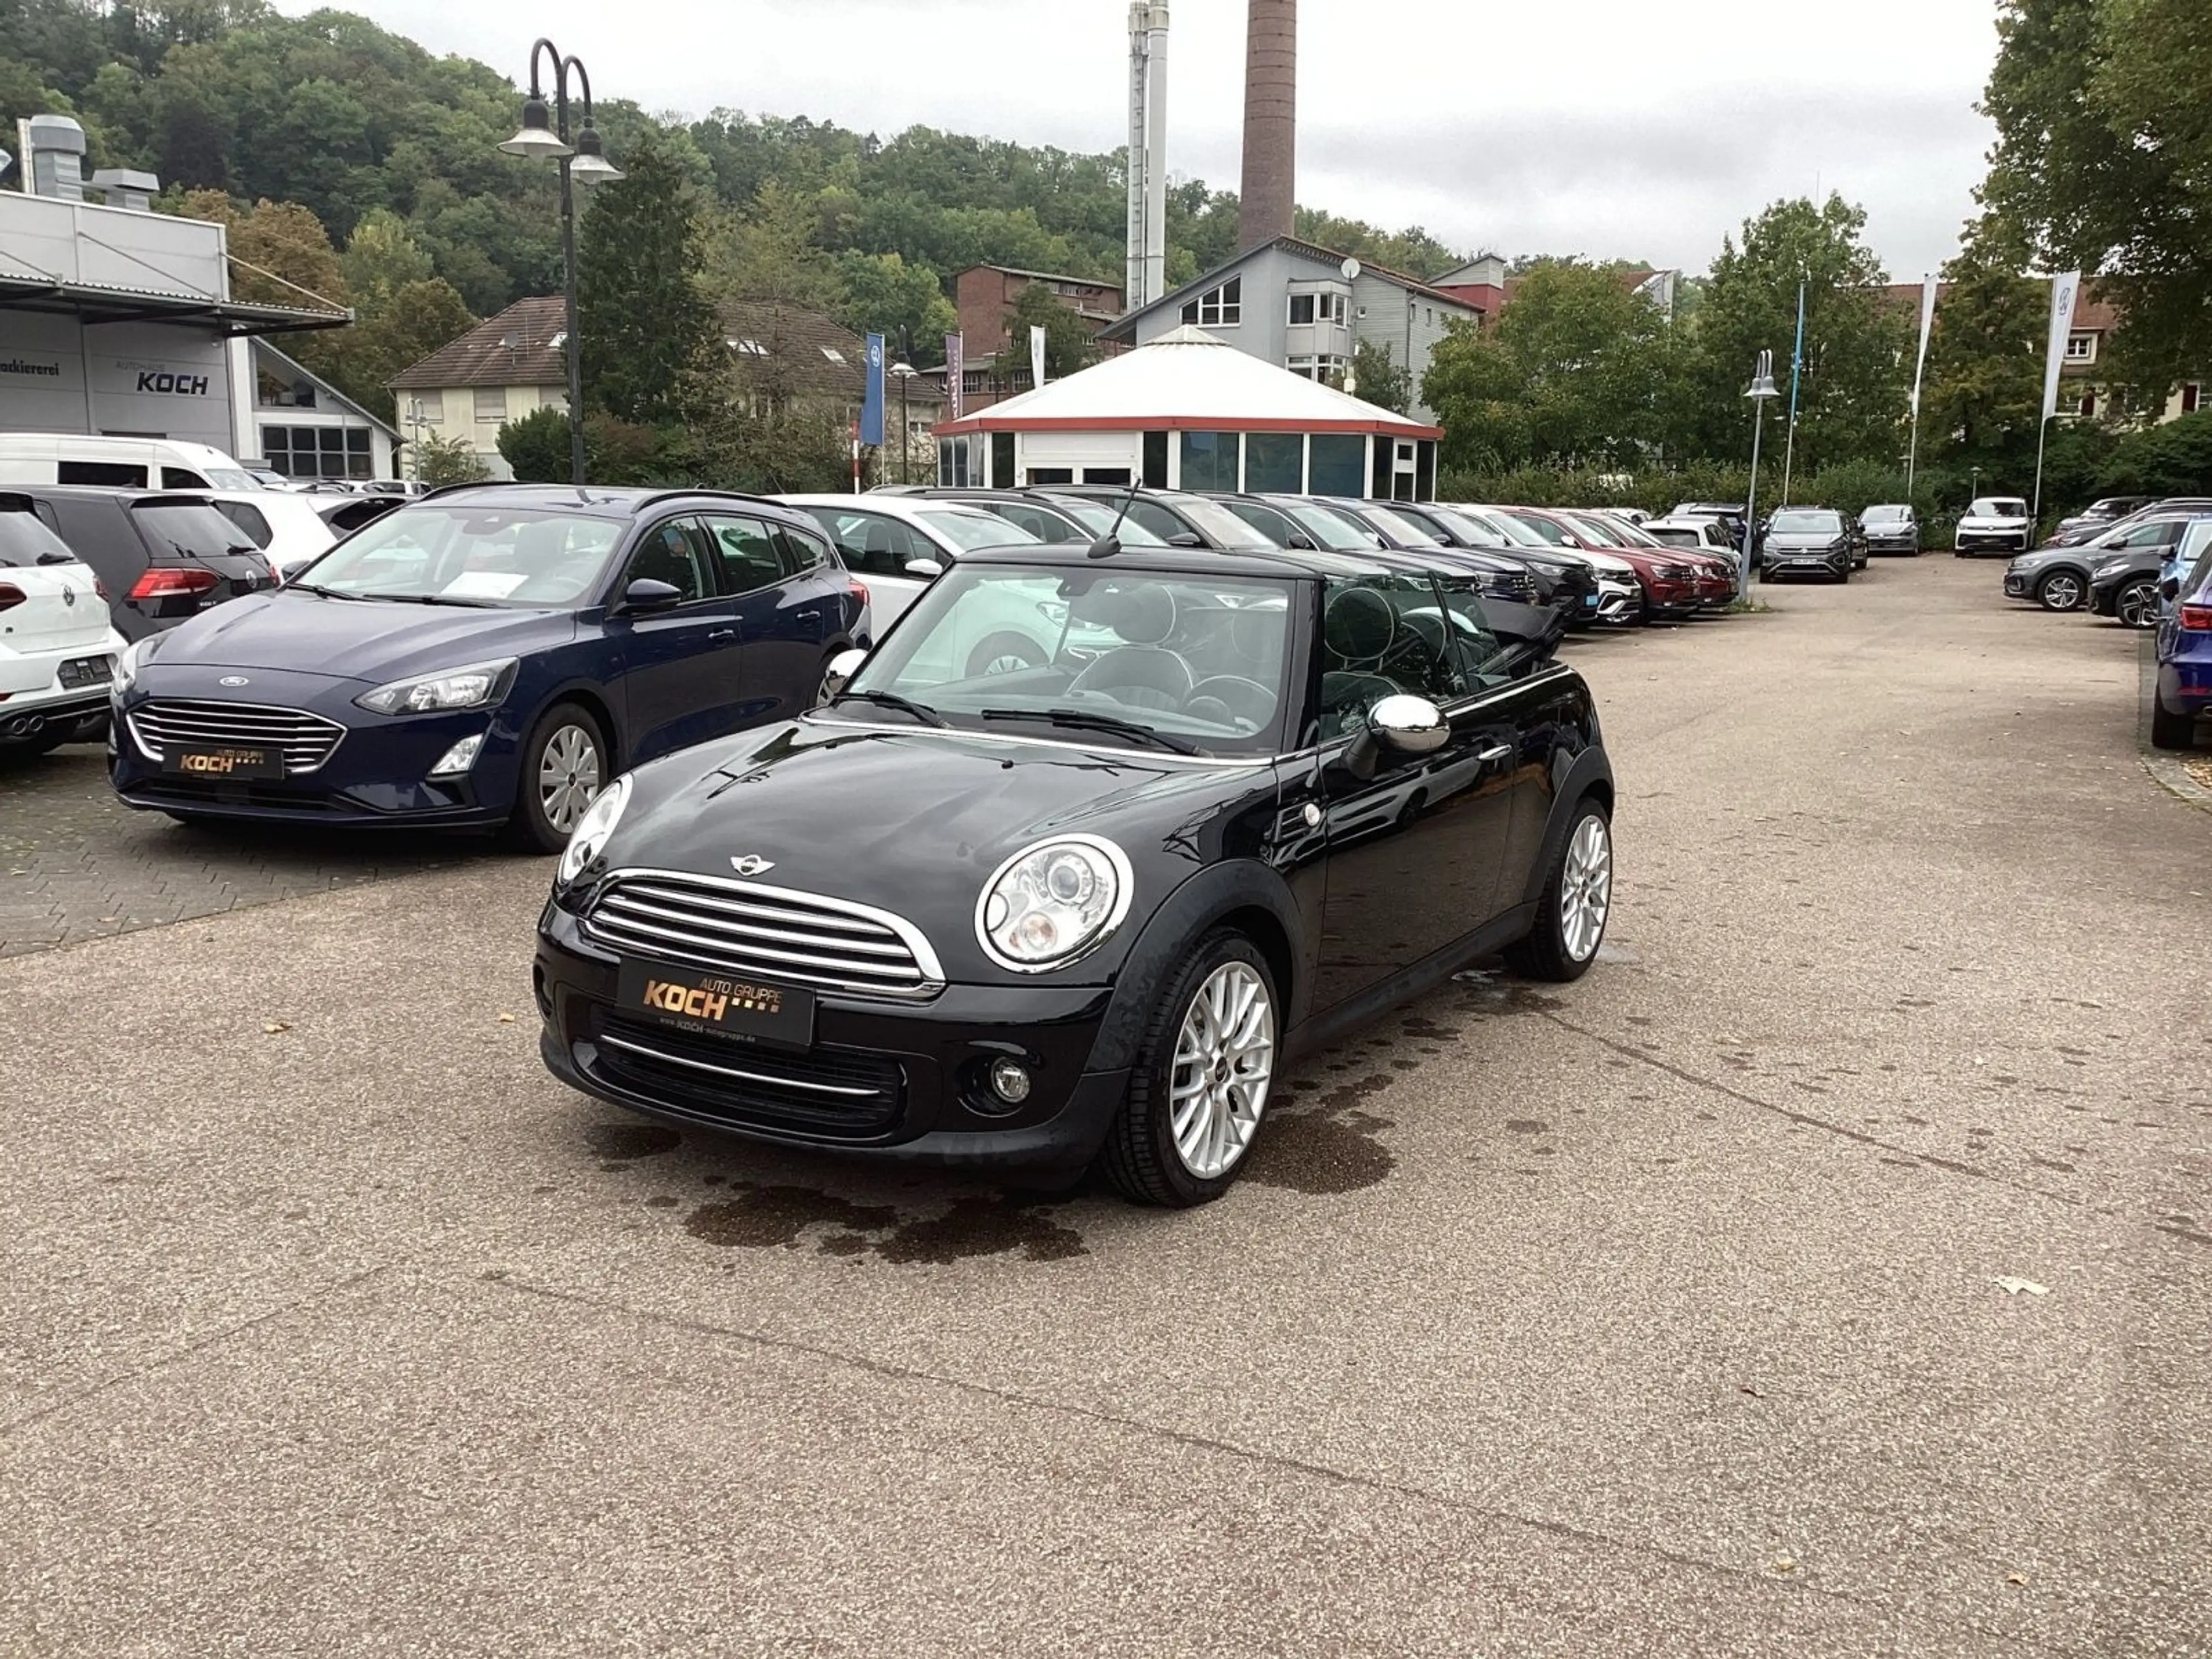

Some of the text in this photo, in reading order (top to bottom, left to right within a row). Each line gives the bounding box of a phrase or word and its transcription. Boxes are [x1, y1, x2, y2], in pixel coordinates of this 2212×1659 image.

[137, 372, 209, 395] KOCH
[180, 754, 233, 772] KOCH
[643, 979, 728, 1021] KOCH
[700, 978, 783, 1003] AUTO GRUPPE
